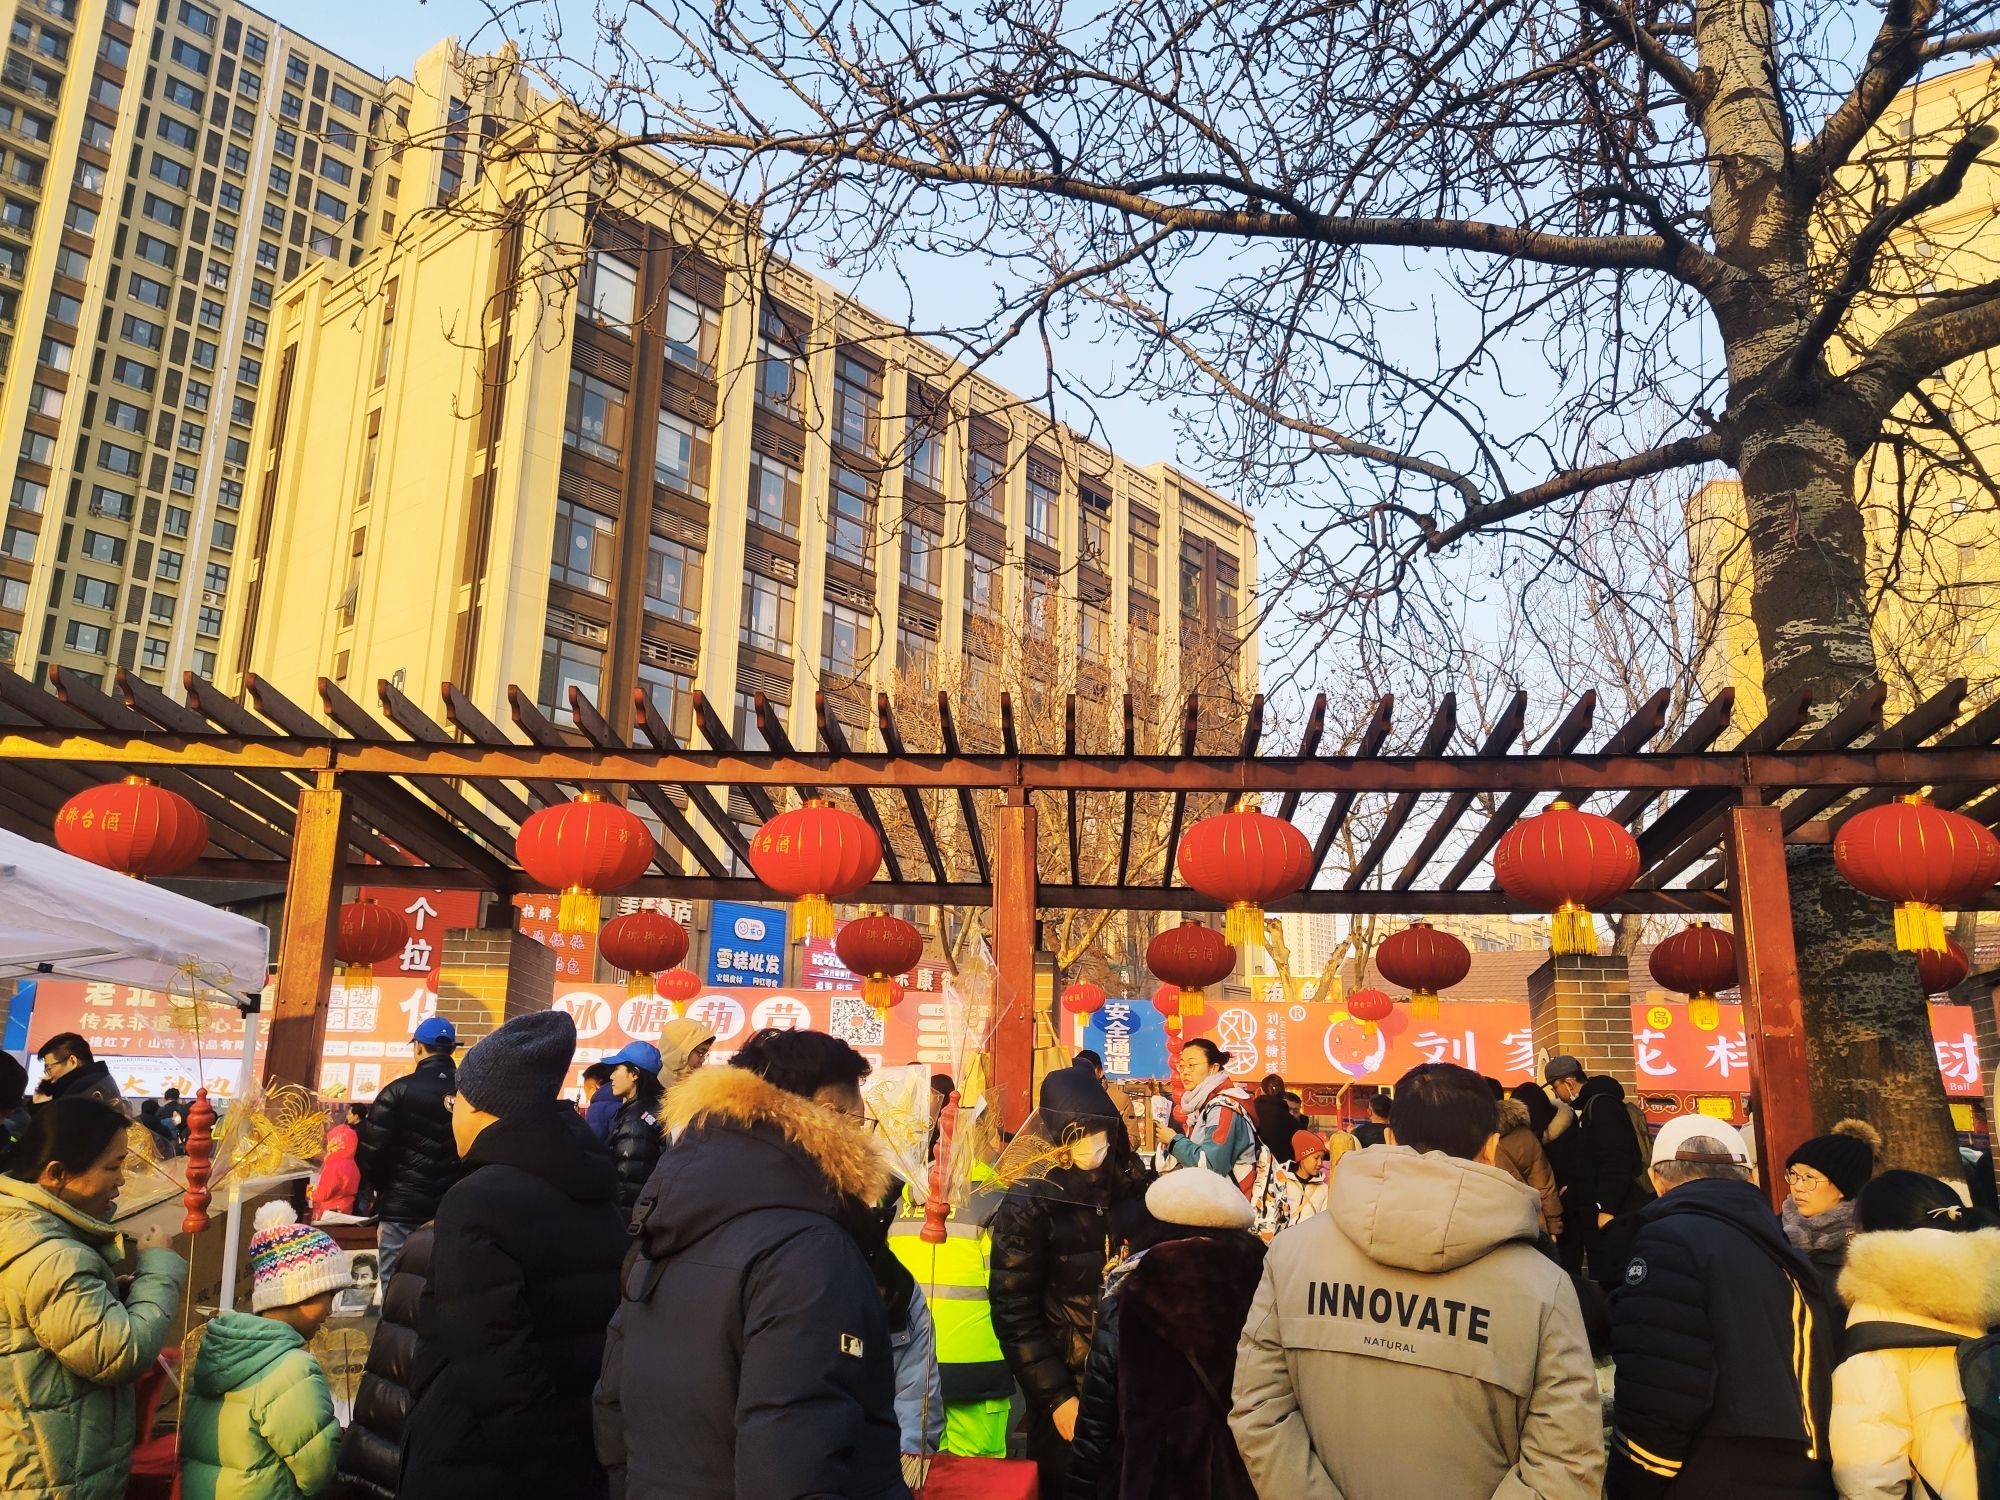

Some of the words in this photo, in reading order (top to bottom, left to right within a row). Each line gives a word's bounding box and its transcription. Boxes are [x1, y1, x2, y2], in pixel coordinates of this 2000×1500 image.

[716, 947, 780, 975] 雪糕批发
[566, 1000, 802, 1035] 冰糖葫芦
[1104, 1002, 1131, 1075] 安全通道
[1949, 1082, 1971, 1091] Ball
[1307, 1281, 1491, 1345] INNOVATE
[1363, 1336, 1417, 1354] NATURAL
